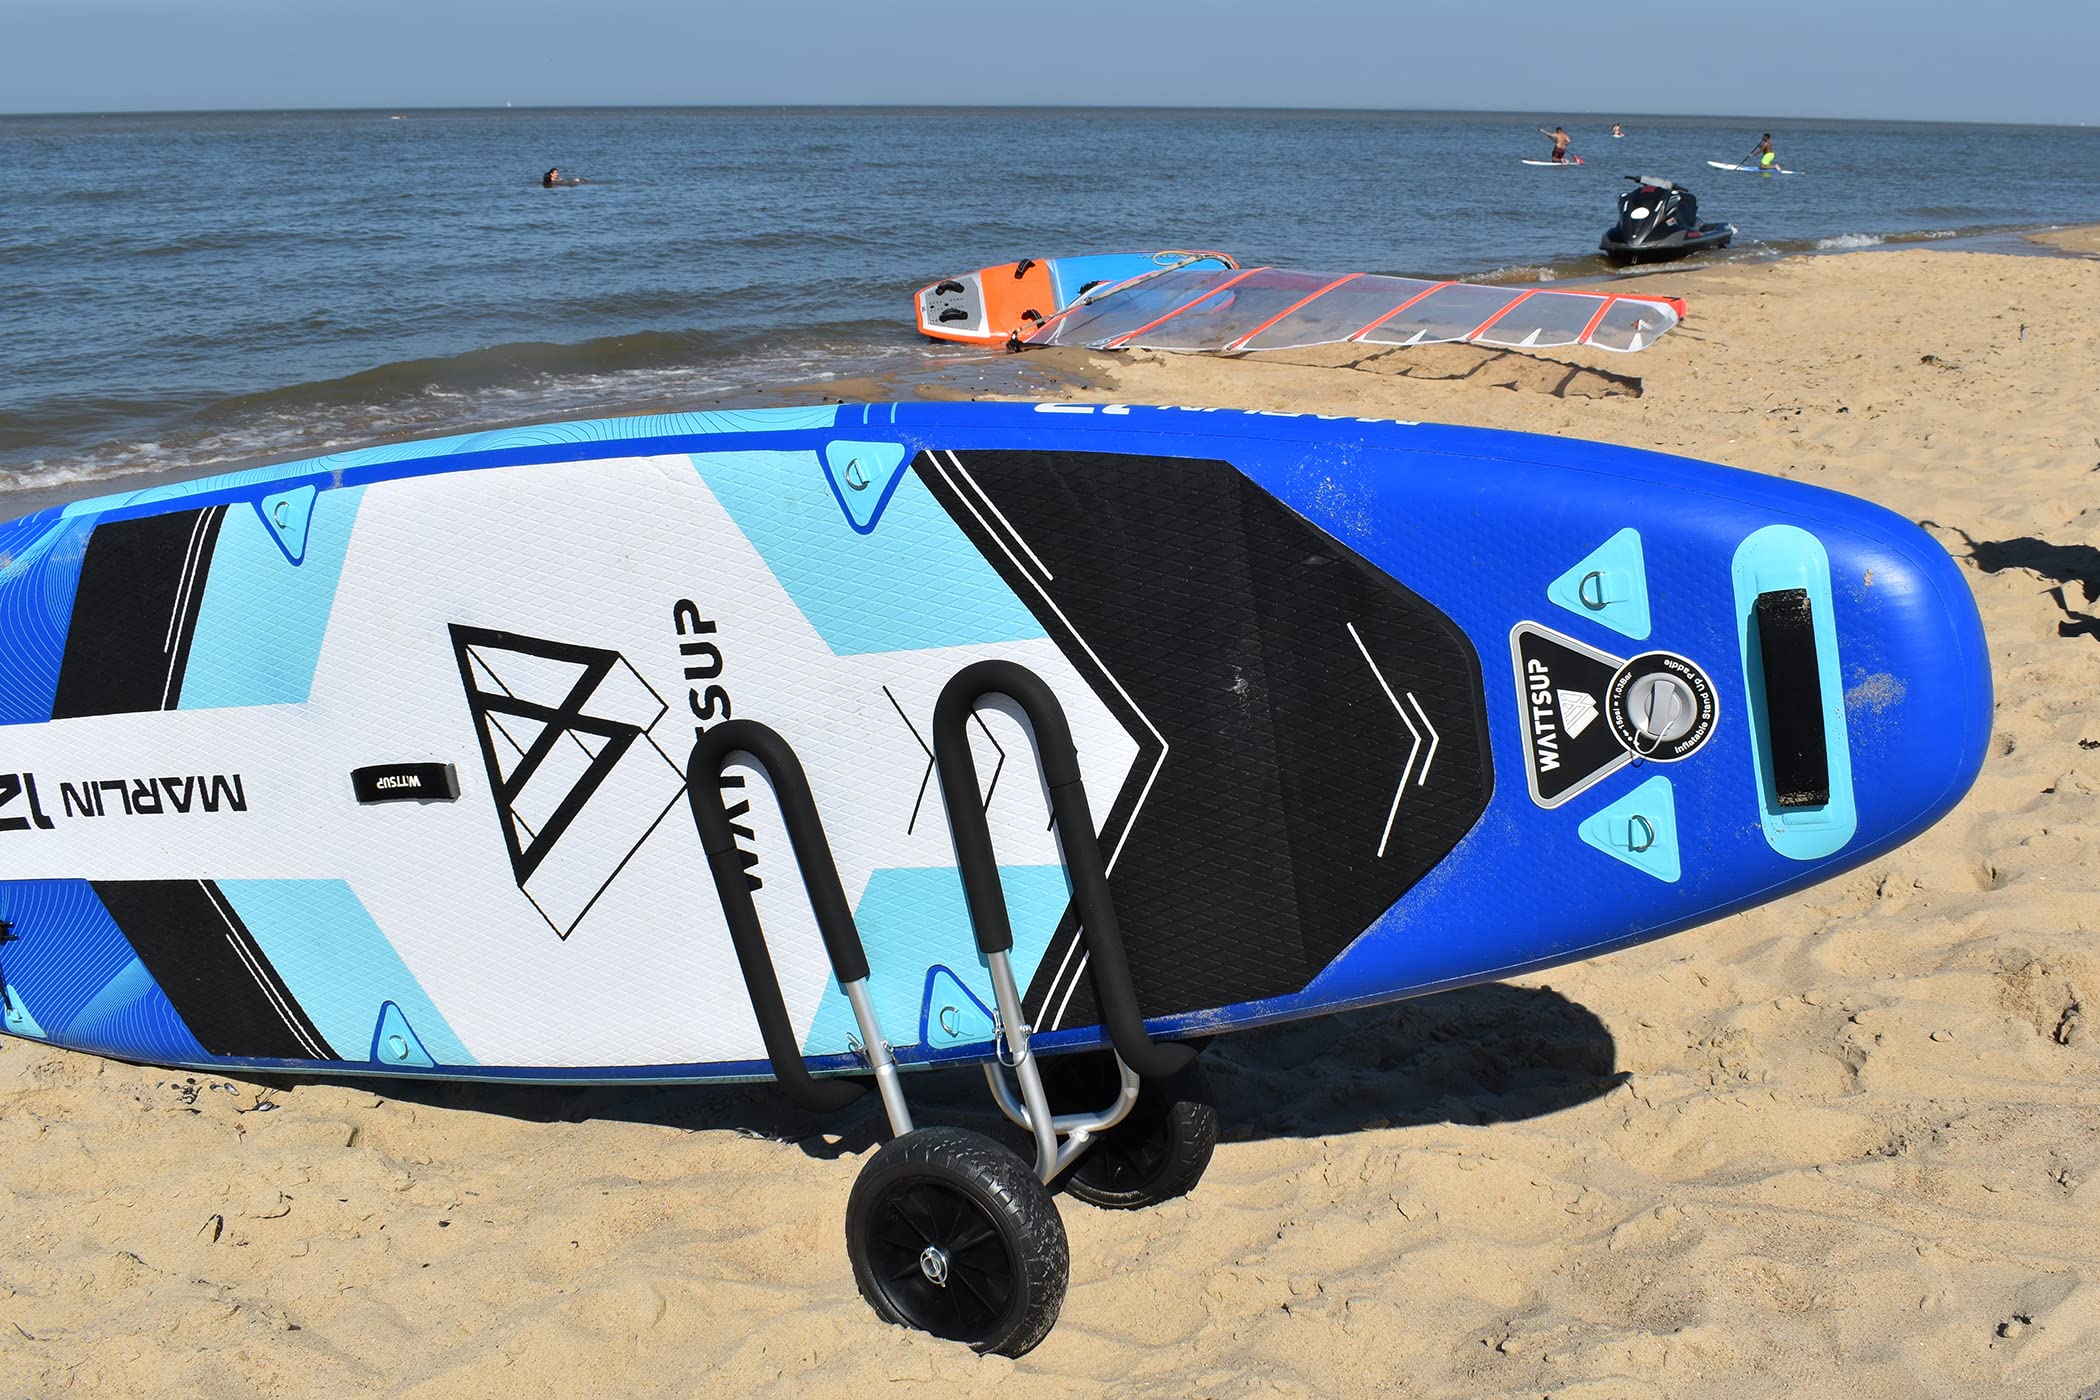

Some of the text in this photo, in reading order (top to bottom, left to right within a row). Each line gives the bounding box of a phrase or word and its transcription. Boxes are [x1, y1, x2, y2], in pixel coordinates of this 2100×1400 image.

[1528, 658, 1560, 772] WATTSUP
[1663, 659, 1711, 754] Inflatable Stand Up Paddle
[60, 774, 247, 817] MARLIN
